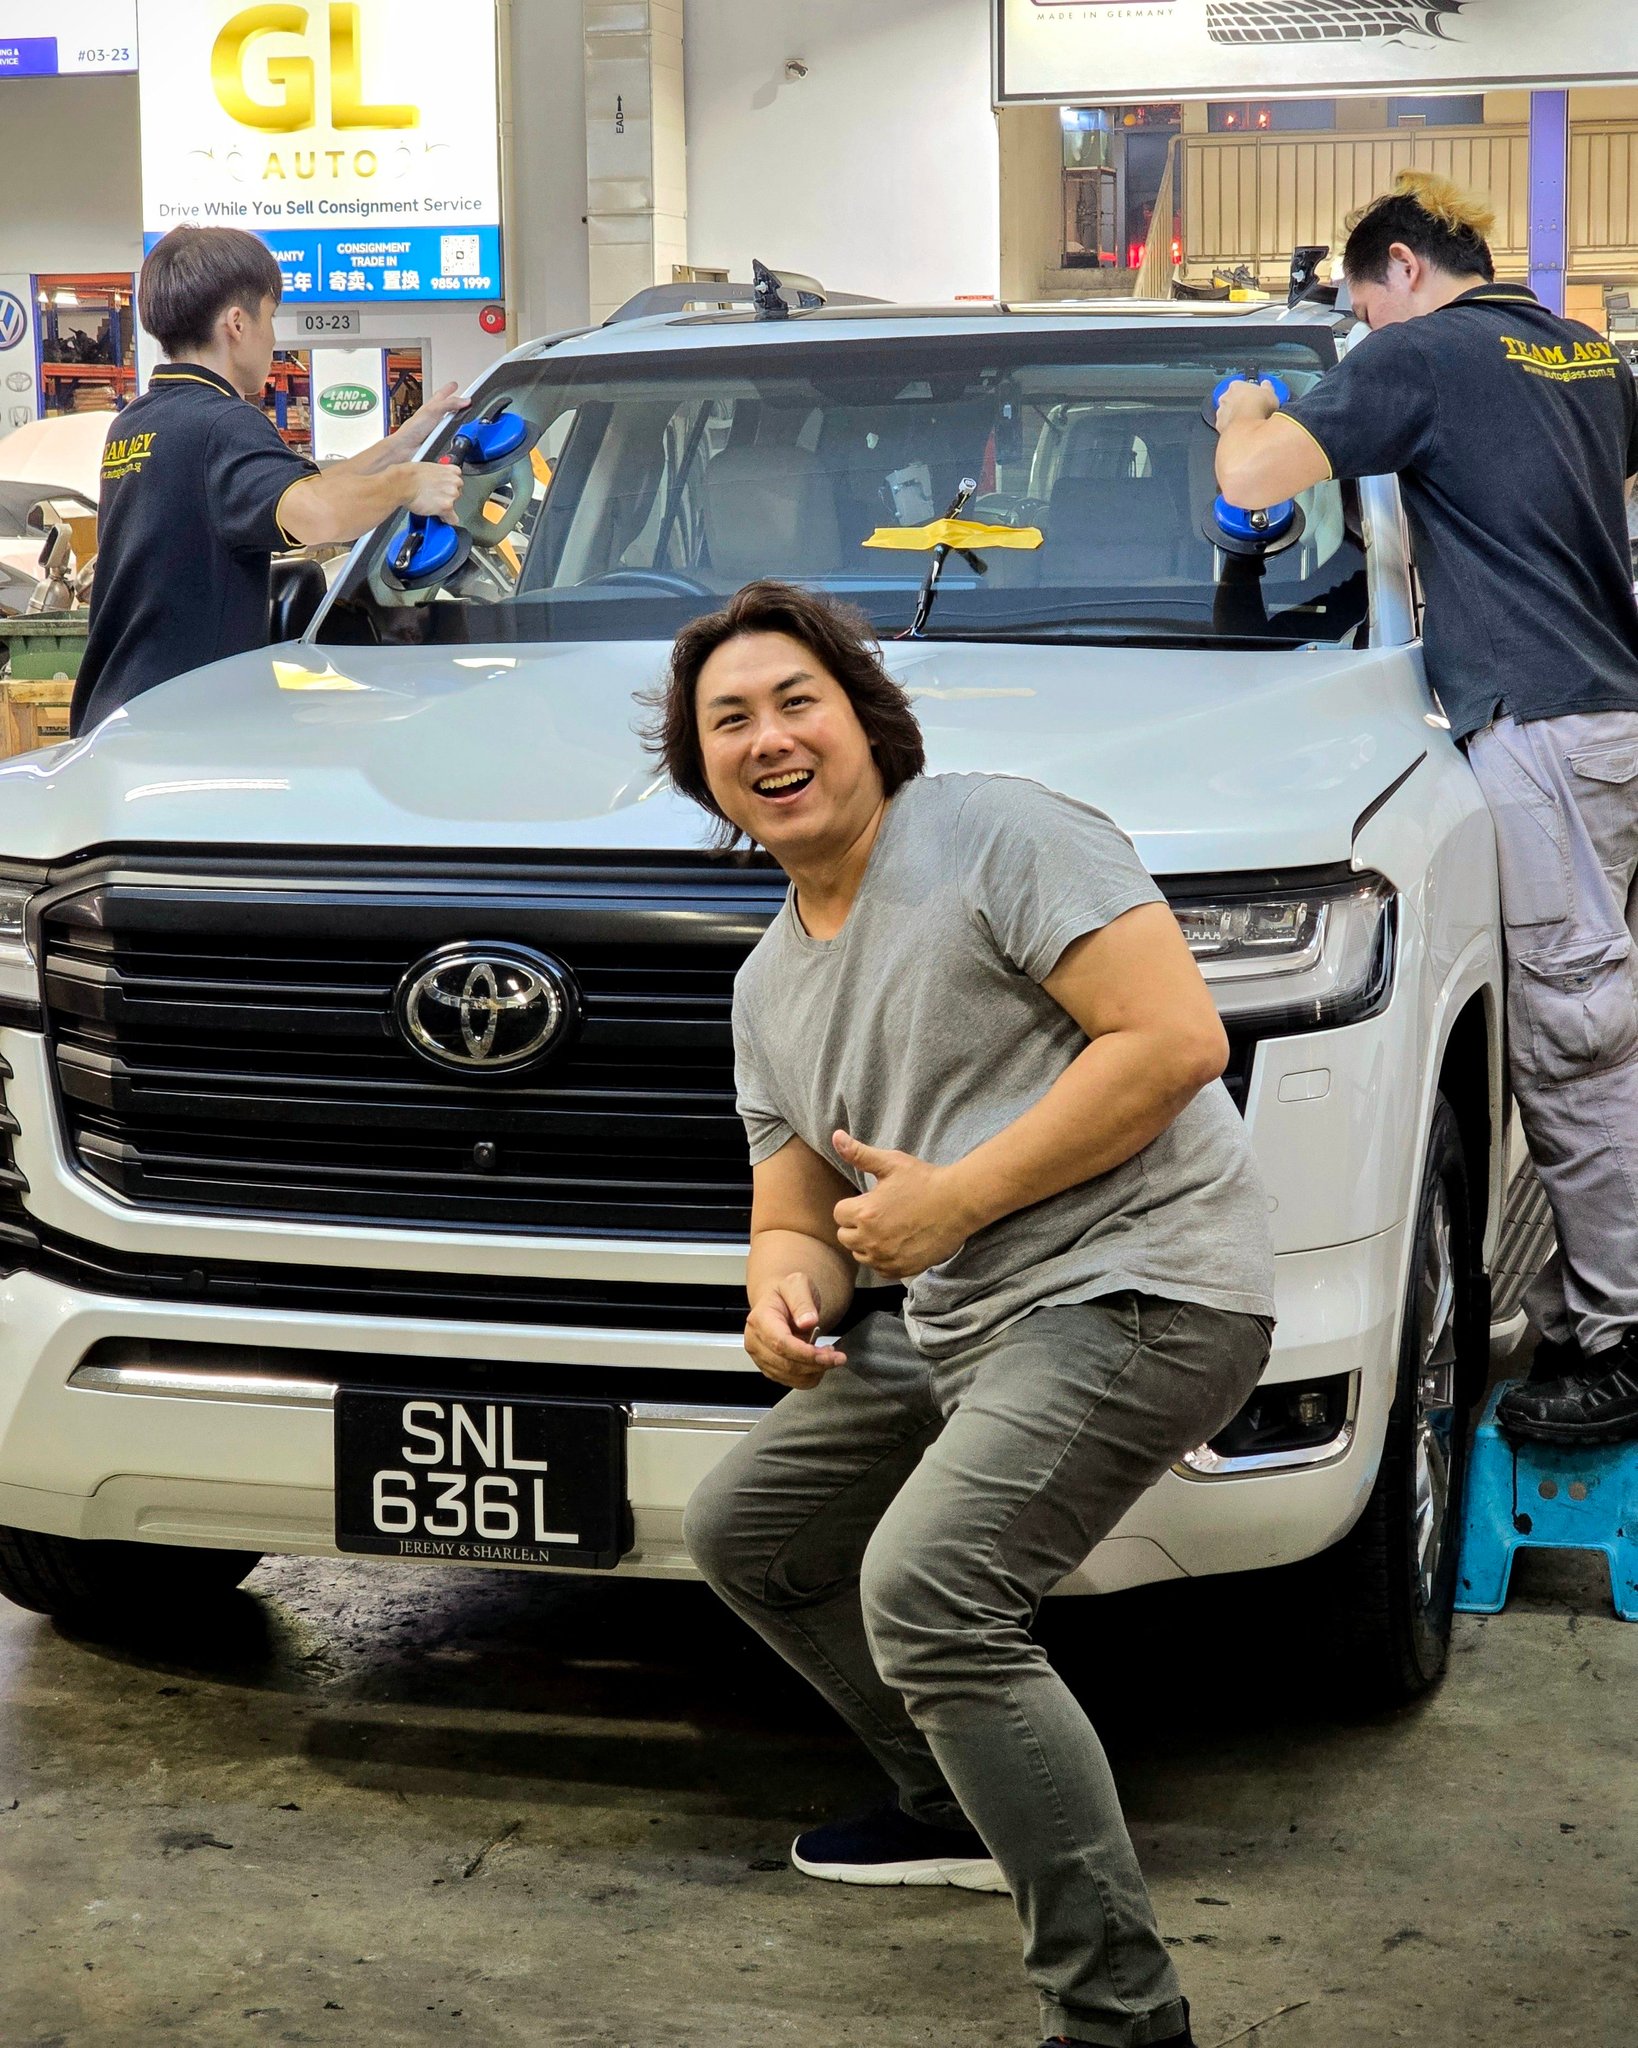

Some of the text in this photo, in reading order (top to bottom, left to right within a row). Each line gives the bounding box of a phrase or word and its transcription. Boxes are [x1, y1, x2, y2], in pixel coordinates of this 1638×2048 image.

[1036, 12, 1073, 20] MADE
[1107, 9, 1174, 18] GERMANY
[78, 48, 130, 61] #03-23
[210, 2, 420, 133] GL
[616, 112, 624, 134] EAD
[262, 150, 378, 180] AUTO
[159, 197, 482, 217] Drive While You Sell Consignment Service
[336, 242, 411, 254] CONSIGNMENT
[351, 255, 398, 268] TRADE IN
[431, 277, 491, 290] 9856 1999
[305, 315, 350, 330] 03-23
[1501, 336, 1611, 364] TEAM AGV
[330, 391, 360, 401] LAND
[333, 401, 370, 411] ROVER
[127, 433, 157, 456] AGV
[401, 1401, 548, 1472] SNL
[400, 1541, 453, 1556] JEREMY
[459, 1547, 469, 1557] &
